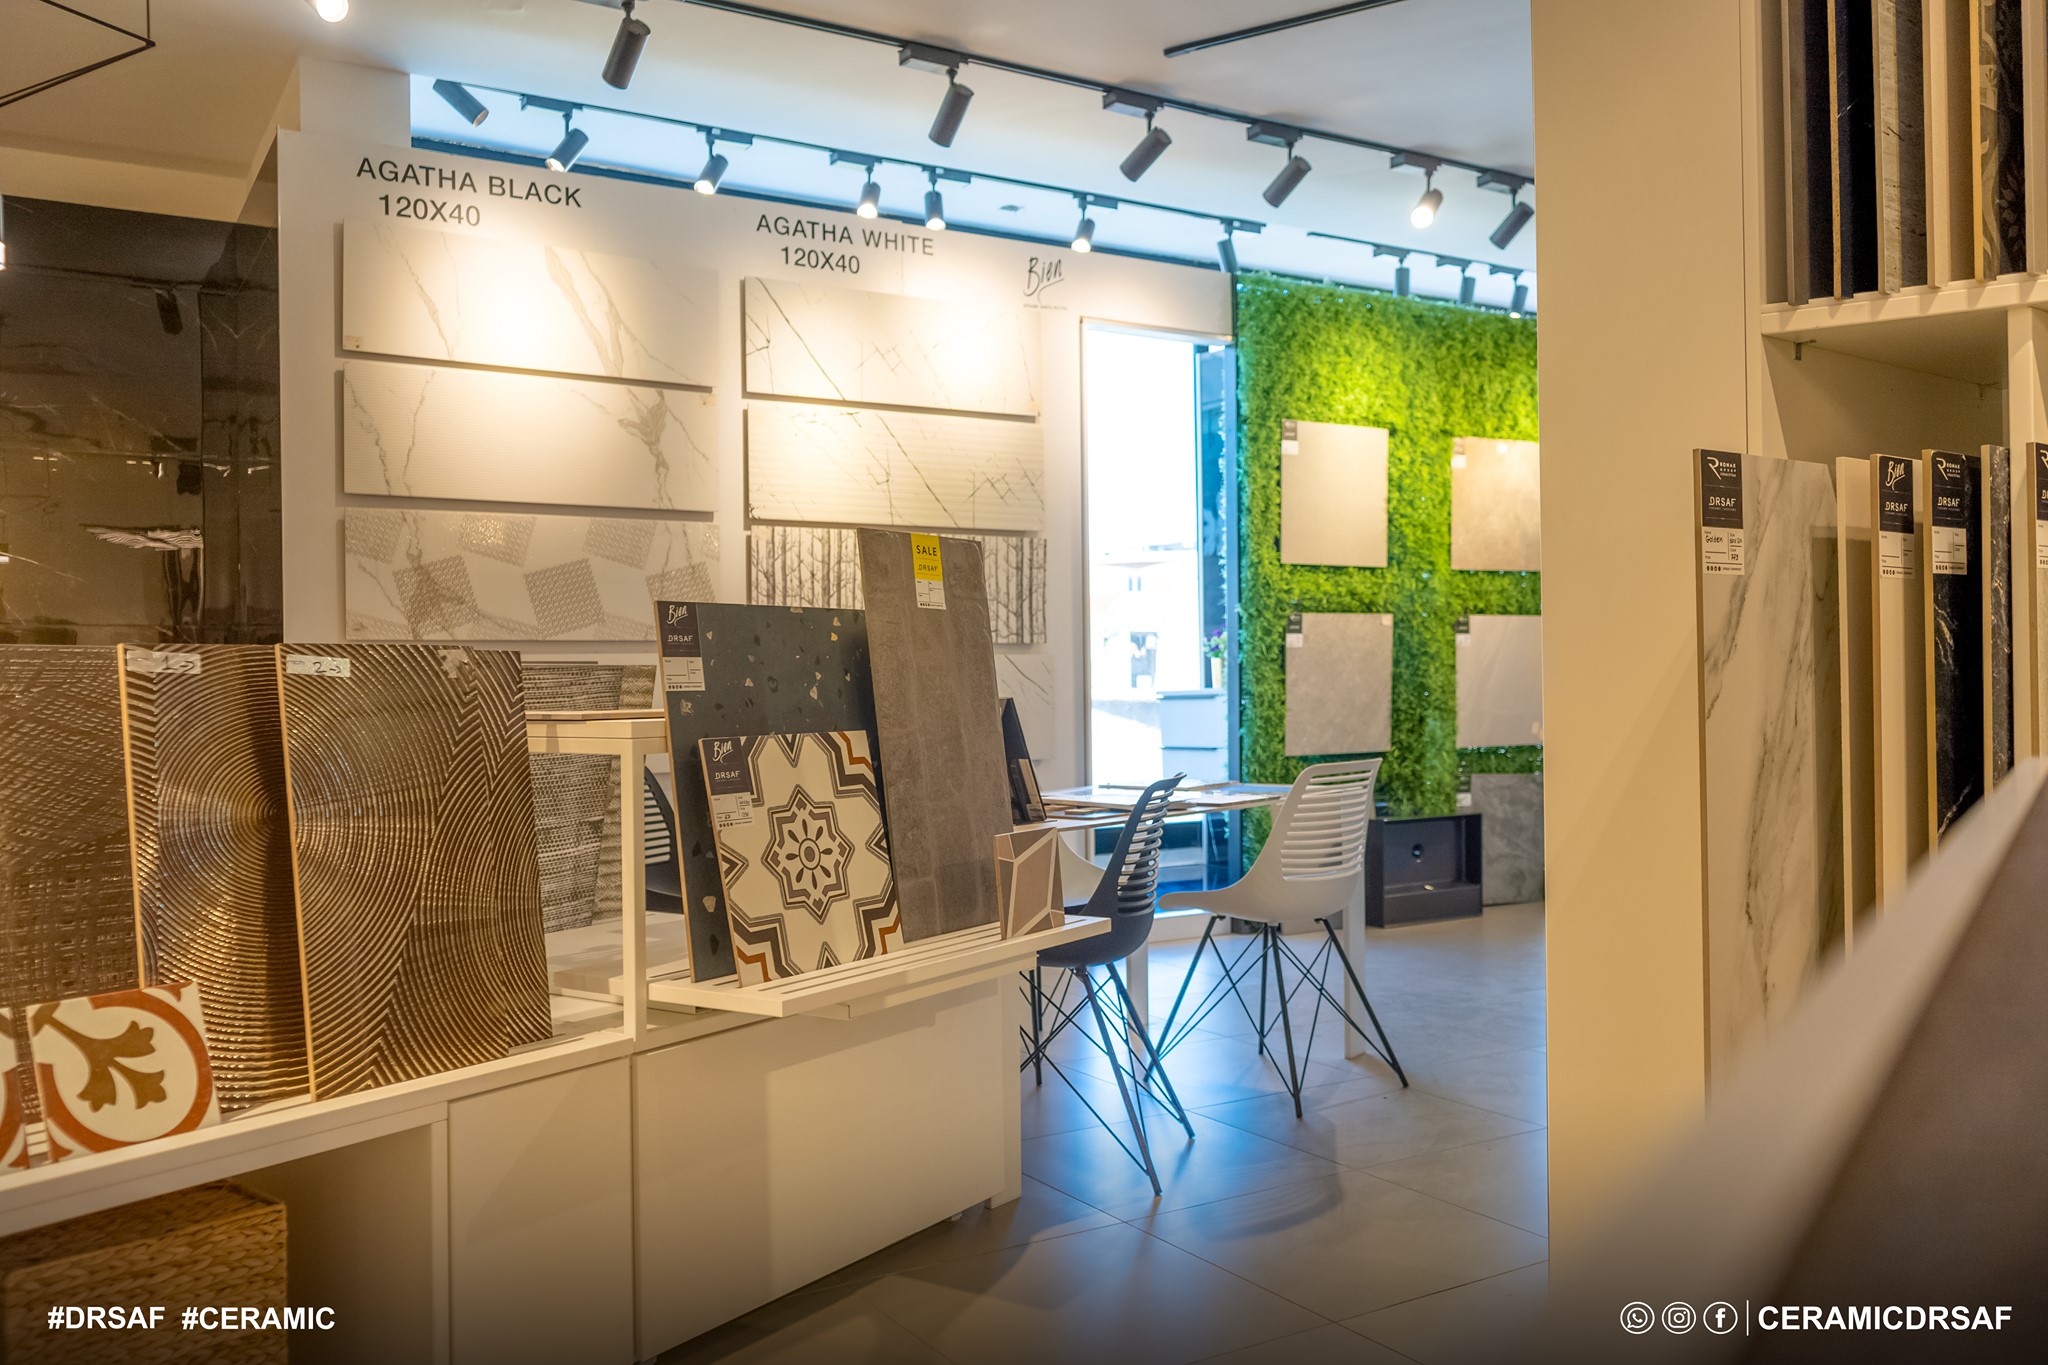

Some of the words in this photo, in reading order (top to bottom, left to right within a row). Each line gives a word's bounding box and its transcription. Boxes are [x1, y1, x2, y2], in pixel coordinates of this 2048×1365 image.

[356, 157, 478, 194] AGATHA
[488, 175, 582, 208] BLACK
[379, 194, 481, 226] 120X40
[756, 214, 853, 245] AGATHA
[861, 228, 935, 256] WHITE
[781, 246, 860, 274] 120X40
[1023, 256, 1065, 304] Bien
[1709, 496, 1736, 507] DRSAF
[1885, 502, 1908, 512] DRSAF
[1937, 497, 1960, 507] DRSAF
[916, 545, 937, 556] SALE
[667, 634, 694, 642] DRSAF
[312, 661, 327, 673] 2
[714, 770, 741, 780] DRSAF
